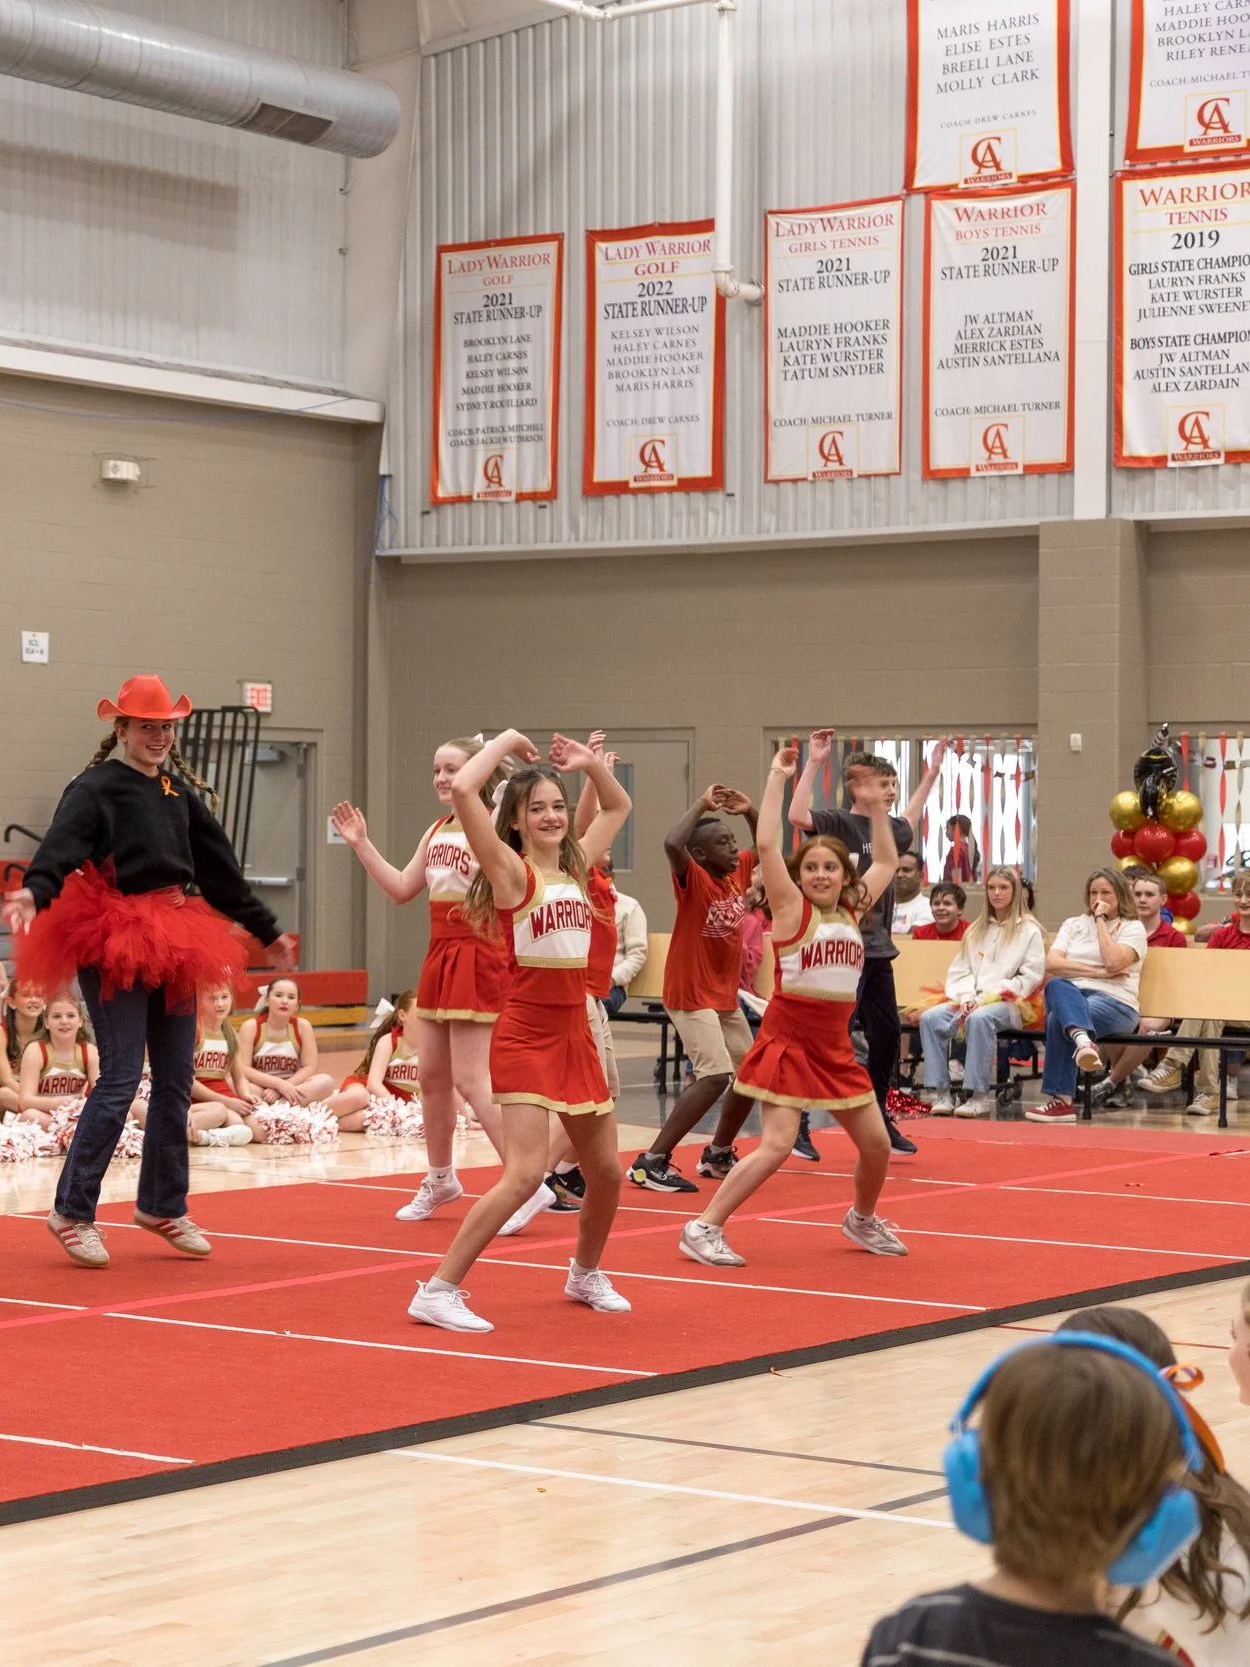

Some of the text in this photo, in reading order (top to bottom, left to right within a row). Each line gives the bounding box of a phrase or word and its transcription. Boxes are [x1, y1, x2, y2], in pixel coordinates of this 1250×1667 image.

[1164, 3, 1210, 17] HALEY
[937, 13, 1039, 39] MARIS HARRIS
[1155, 13, 1250, 32] MADDIE HOO
[945, 32, 1031, 57] ELISE ESTES
[1158, 30, 1235, 47] BROOKLYN
[996, 51, 1034, 67] LANE
[1166, 44, 1250, 61] RILEY RENE
[936, 68, 1040, 94] MOLLY CLARK
[1150, 76, 1186, 88] COACH
[1191, 73, 1238, 85] MICHAEL
[940, 109, 1037, 129] COACH DREW CARNES
[1192, 135, 1240, 145] WARRIORS
[1139, 182, 1250, 206] WARRIOR
[954, 203, 1048, 223] WARRIOR
[1165, 208, 1228, 225] TENNIS
[775, 213, 894, 237] LADY WARRIOR
[955, 223, 1041, 241] BOYS TENNIS
[789, 235, 879, 254] GIRLS TENNIS
[1172, 230, 1220, 250] 2019
[604, 239, 711, 261] LADY WARRIOR
[981, 245, 1017, 262] 2021
[447, 252, 551, 274] LADY WARRIOR
[634, 261, 679, 276] GOLF
[816, 257, 851, 273] 2021
[941, 258, 1059, 281] STATE RUNNER-UP
[1129, 254, 1250, 276] GIRLS STATE CHAMPIO
[483, 274, 514, 286] GOLF
[638, 280, 673, 297] 2022
[778, 270, 891, 293] STATE RUNNER-UP
[1148, 272, 1246, 290] LAURYN FRANKS
[483, 292, 513, 308] 2021
[1151, 287, 1243, 304] KATE WURSTER
[454, 305, 542, 325] STATE RUNNER-UP
[604, 296, 707, 320] STATE RUNNER-UP
[1139, 303, 1196, 320] JULIENNE
[964, 310, 1033, 327] JW ALTMAN
[611, 324, 699, 340] KELSEY WILSON
[777, 319, 890, 339] MADDIE HOOKER
[956, 324, 1042, 341] ALEX ZARDIAN
[510, 334, 532, 343] LANE
[613, 339, 697, 353] HALEY CARNES
[780, 333, 887, 353] LAURYN FRANKS
[954, 338, 1044, 355] MERRICK ESTES
[1130, 335, 1191, 350] BOYS STATE
[606, 352, 704, 367] MADDIE HOOKER
[783, 348, 883, 367] KATE WURSTER
[937, 351, 1060, 370] AUSTIN SANTELLANA
[1158, 349, 1230, 366] JW ALTMAN
[607, 365, 701, 380] BROOKLYN LANE
[782, 363, 884, 381] TATUM SNYDER
[1133, 362, 1250, 380] AUSTIN SANTELLAN
[616, 380, 694, 392] MARIS HARRIS
[1151, 378, 1240, 393] ALEX ZARDAIN
[974, 404, 1018, 415] MICHAEL
[1021, 401, 1061, 411] TURNER
[811, 415, 852, 425] MICHAEL
[856, 411, 893, 422] TURNER
[530, 900, 590, 939] WARRIOR
[801, 941, 864, 971] WARRIOR
